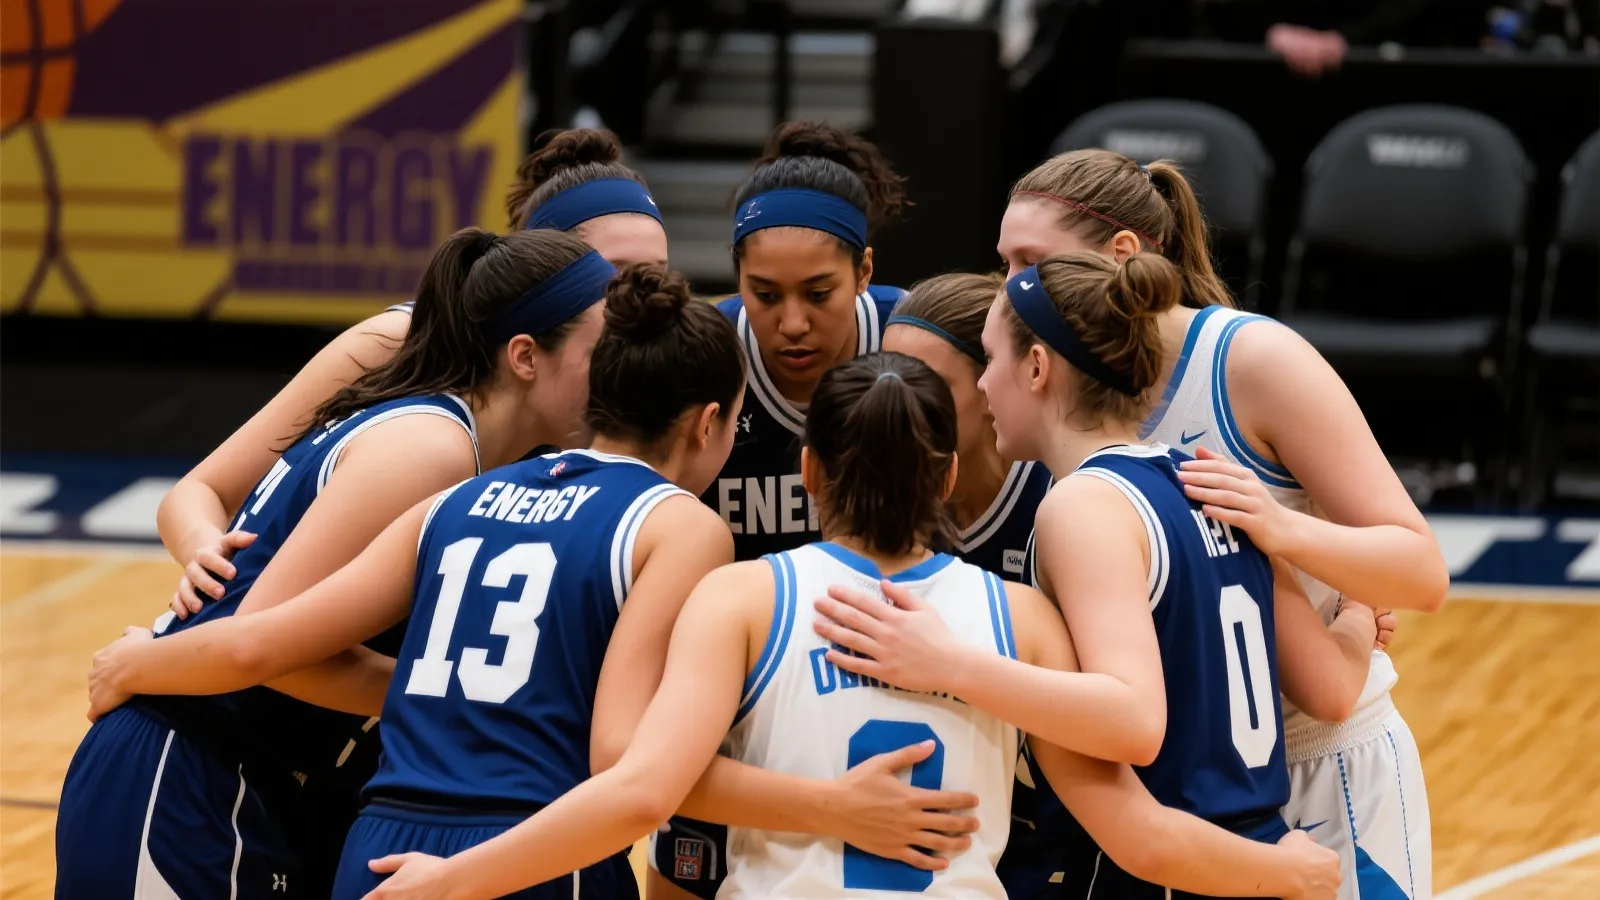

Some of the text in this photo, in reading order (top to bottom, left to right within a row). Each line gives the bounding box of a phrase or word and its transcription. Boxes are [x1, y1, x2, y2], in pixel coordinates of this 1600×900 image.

[183, 135, 494, 251] ENERGY
[468, 481, 601, 524] ENERGY
[404, 537, 558, 704] 13
[1219, 584, 1278, 769] 0
